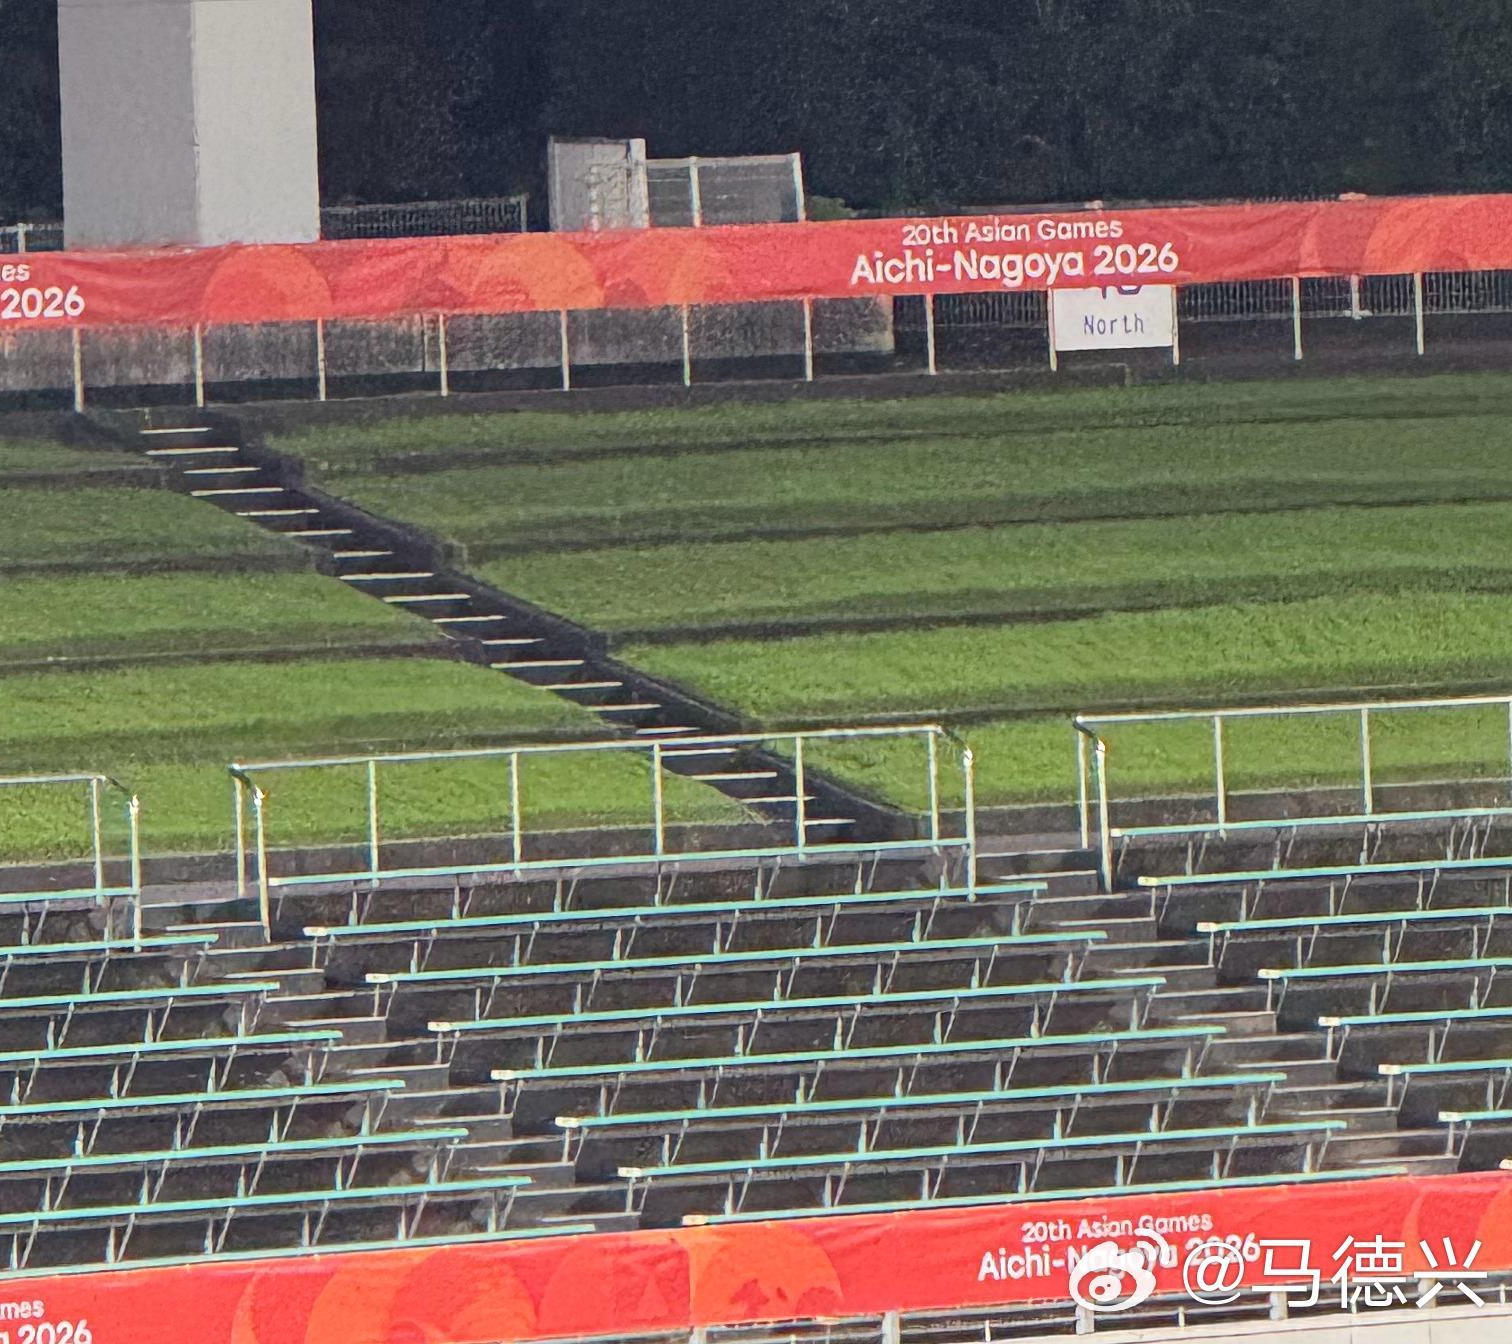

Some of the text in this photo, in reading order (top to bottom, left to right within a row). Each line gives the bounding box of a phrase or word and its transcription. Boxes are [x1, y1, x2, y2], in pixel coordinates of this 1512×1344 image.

[902, 217, 1123, 246] 20th Asian Games
[850, 242, 1180, 288] Aichi-Nagoya 2026
[0, 286, 86, 320] 2026
[1083, 313, 1145, 336] North
[1021, 1213, 1214, 1243] 20th Asian Games
